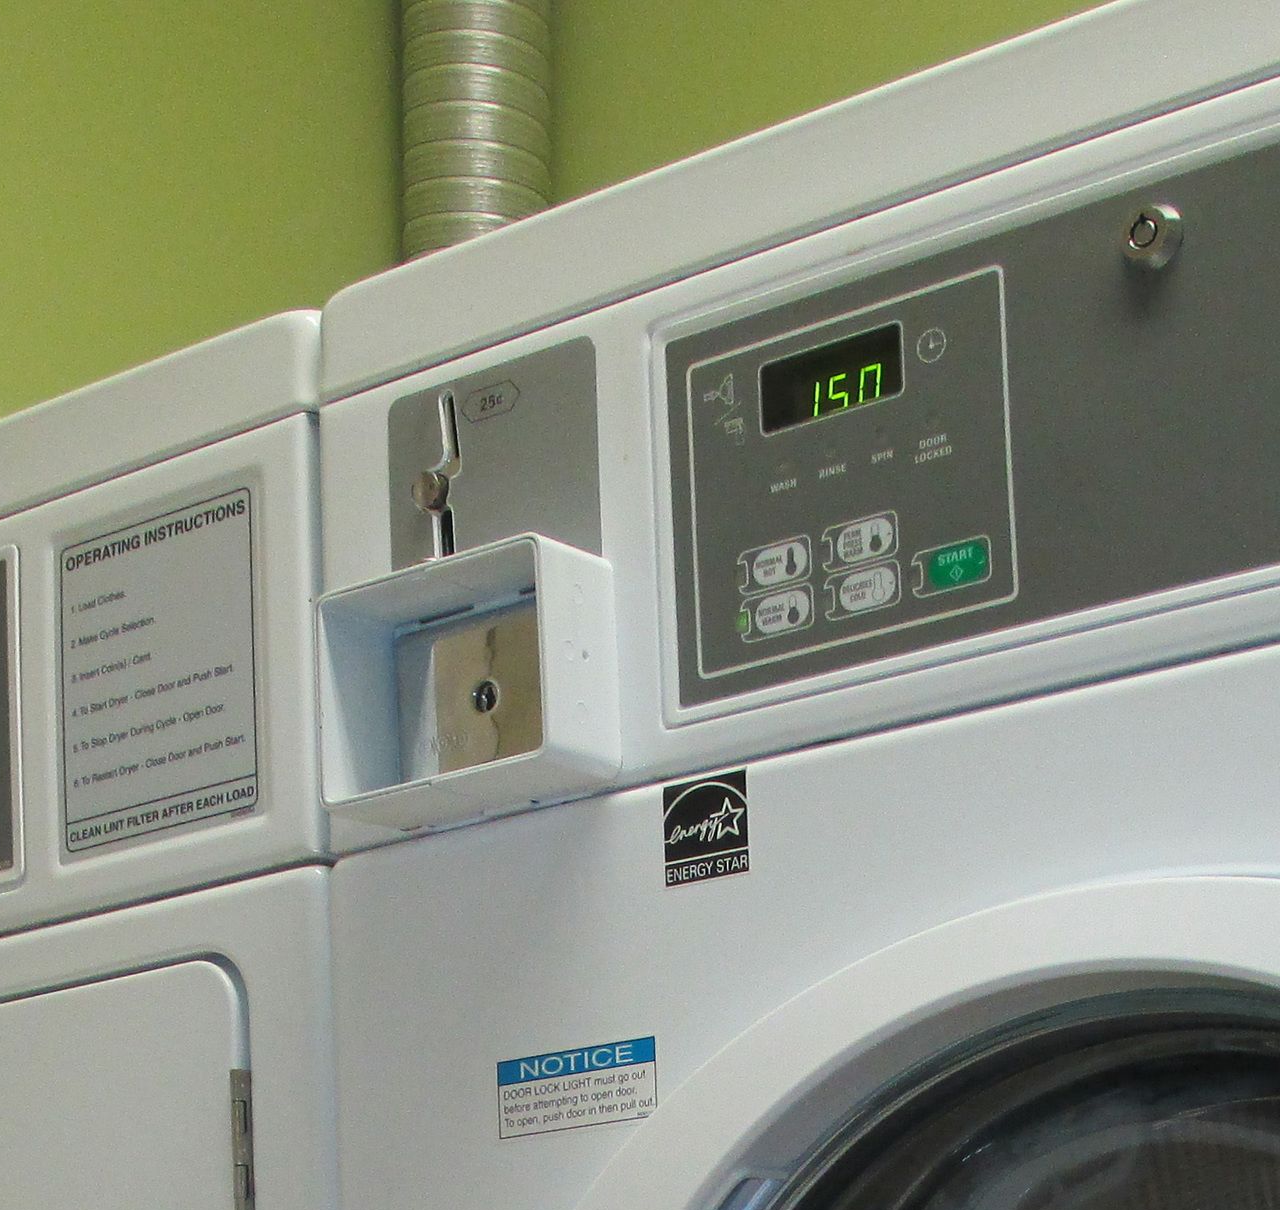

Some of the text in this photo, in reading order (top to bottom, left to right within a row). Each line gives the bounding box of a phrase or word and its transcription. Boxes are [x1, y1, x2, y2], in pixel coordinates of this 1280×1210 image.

[914, 445, 952, 464] LOCKED
[919, 432, 947, 449] DOOR
[819, 462, 847, 479] RINSE
[871, 450, 894, 464] SPIN
[66, 499, 245, 571] OPERATING INSTRUCTIONS
[938, 546, 973, 566] START
[70, 786, 254, 843] CLEAN LINT FILTER AFTER EACH LOAD
[666, 854, 748, 883] ENERGY STAR
[520, 1044, 633, 1079] NOTICE
[503, 1069, 645, 1101] DOOR LOCK LIGHT must go out
[504, 1086, 637, 1115] before attempting to open door.
[504, 1118, 515, 1128] To
[543, 1111, 564, 1124] push
[566, 1108, 586, 1119] door
[588, 1107, 597, 1115] in
[598, 1103, 618, 1114] then
[620, 1099, 636, 1111] pull
